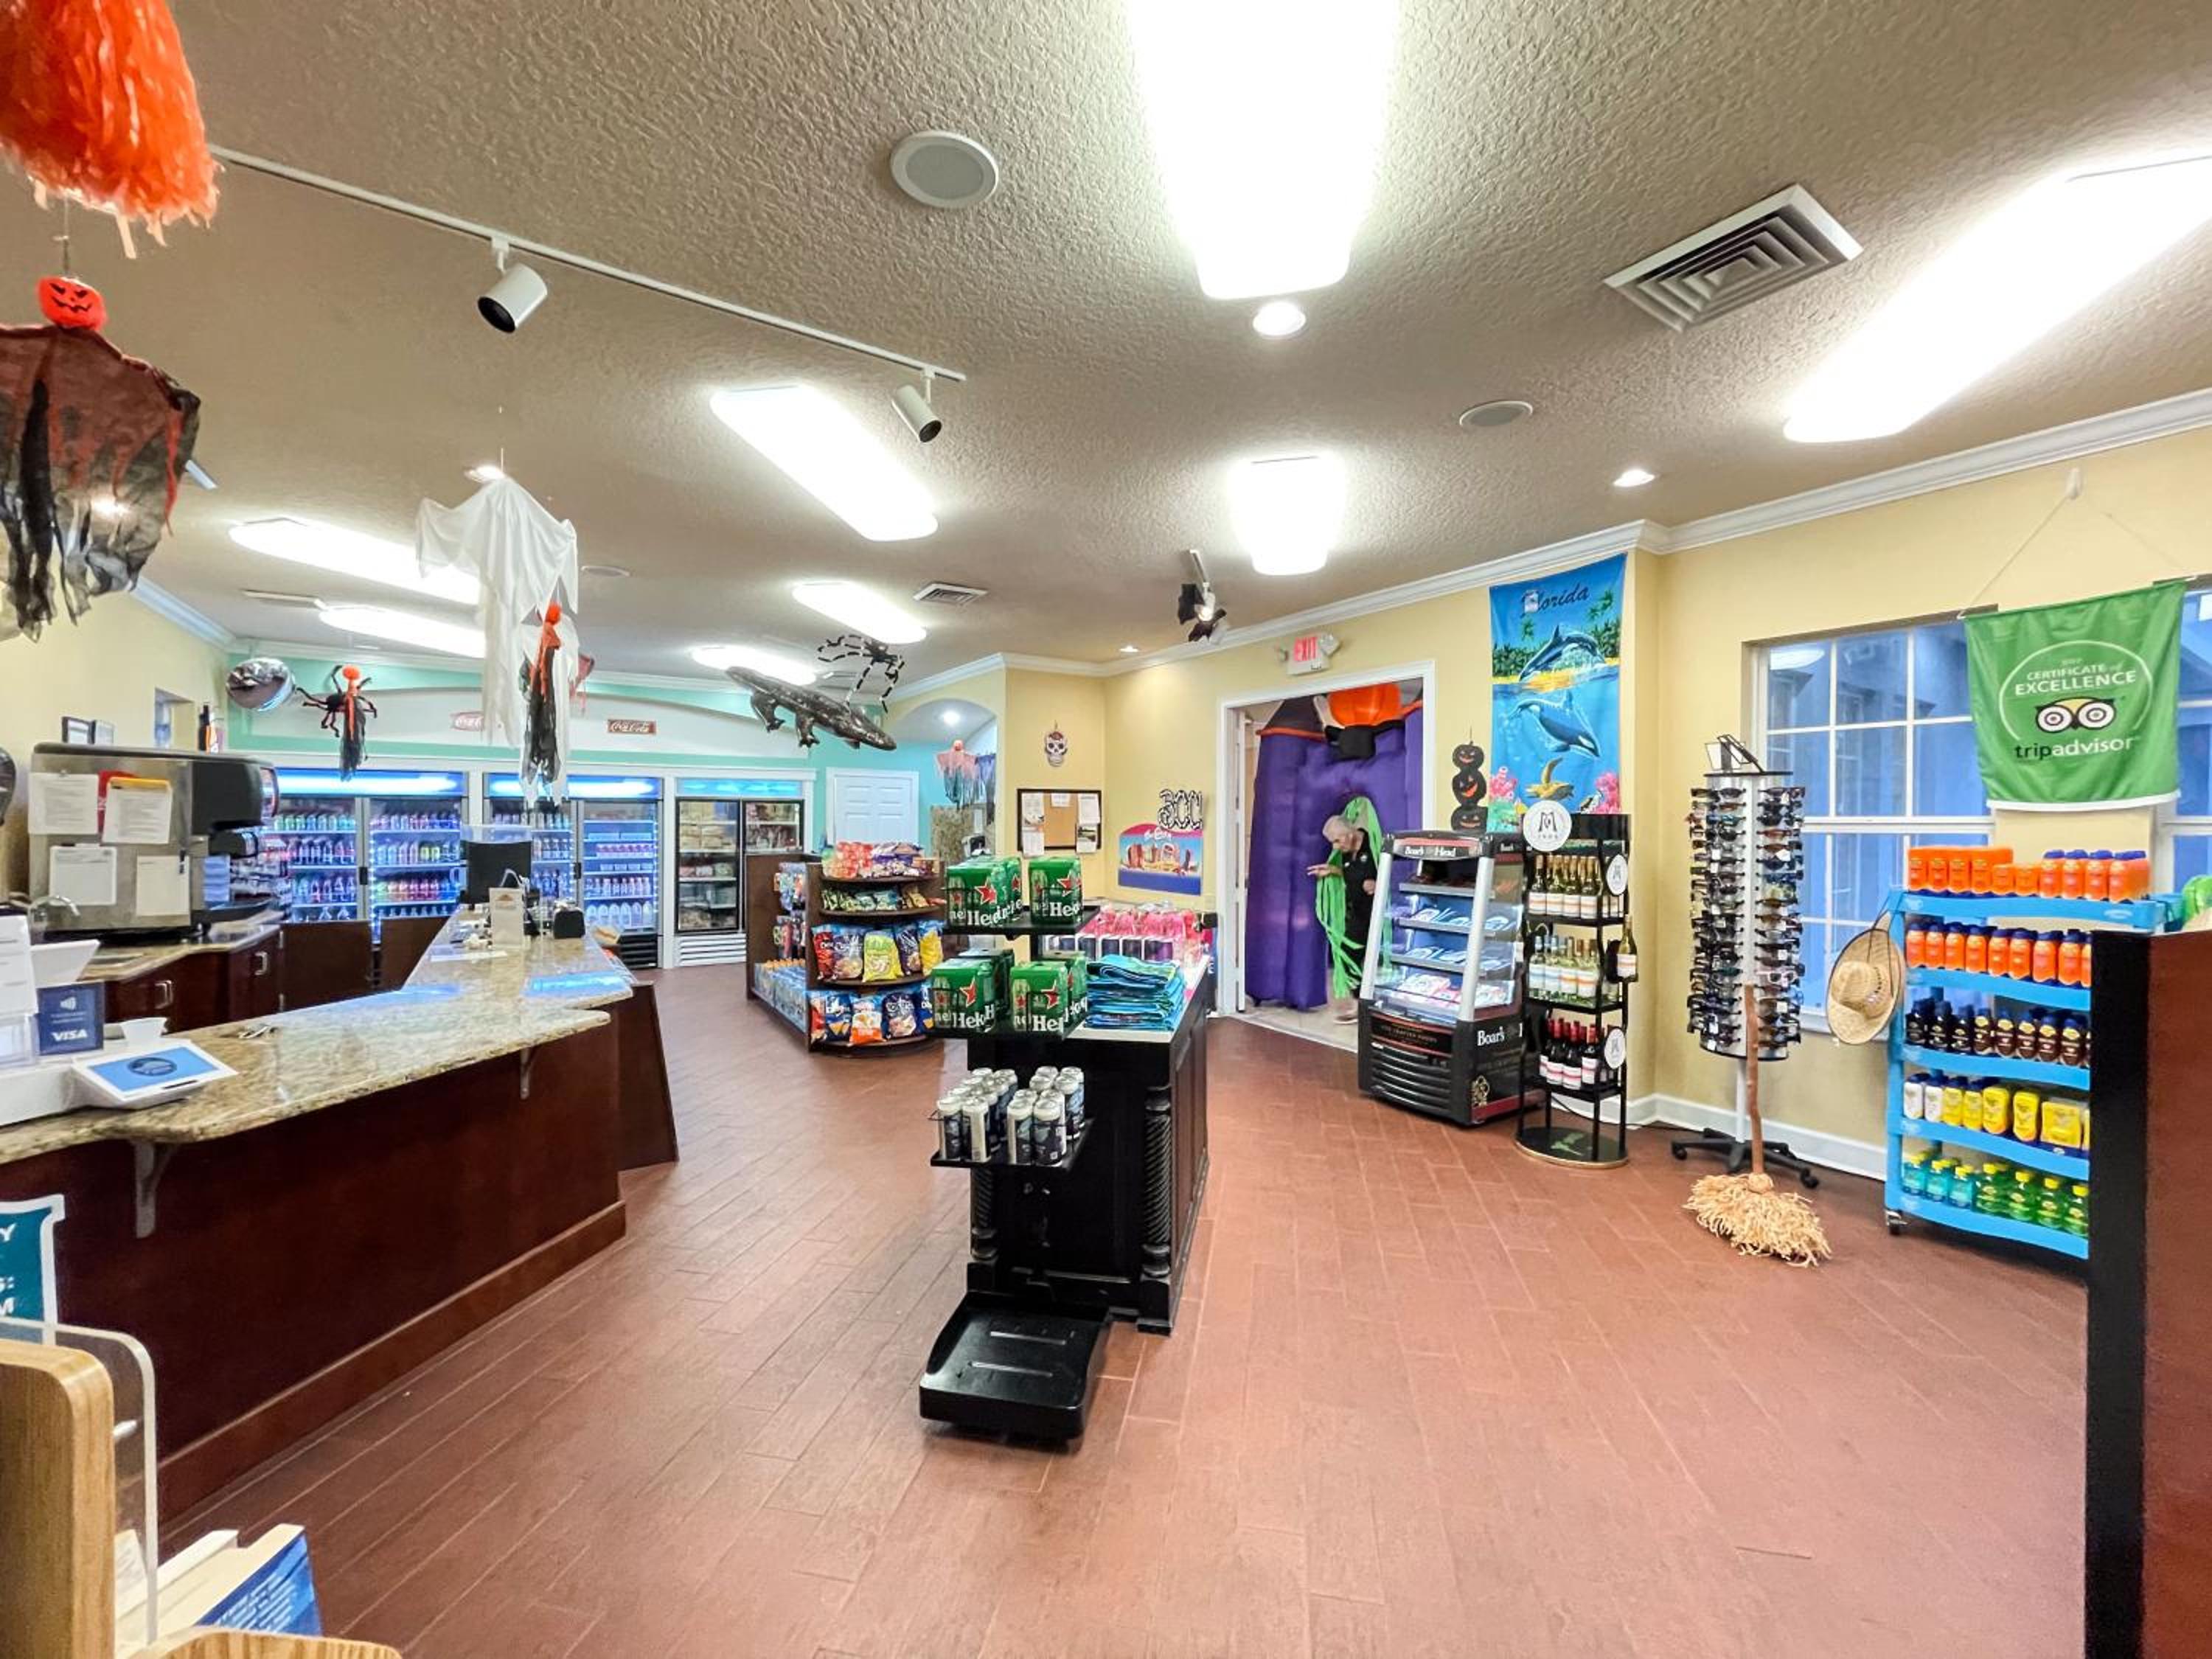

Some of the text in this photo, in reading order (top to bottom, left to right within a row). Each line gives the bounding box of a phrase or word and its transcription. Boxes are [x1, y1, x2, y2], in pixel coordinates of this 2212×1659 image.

[1294, 636, 1318, 661] EXIT
[2027, 664, 2104, 681] CERTIFICATE
[2015, 671, 2137, 695] EXCELLENCE
[2014, 737, 2135, 761] tripadvisor
[1435, 847, 1456, 858] Head
[51, 1028, 88, 1042] VISA
[1477, 1026, 1505, 1046] Boar's
